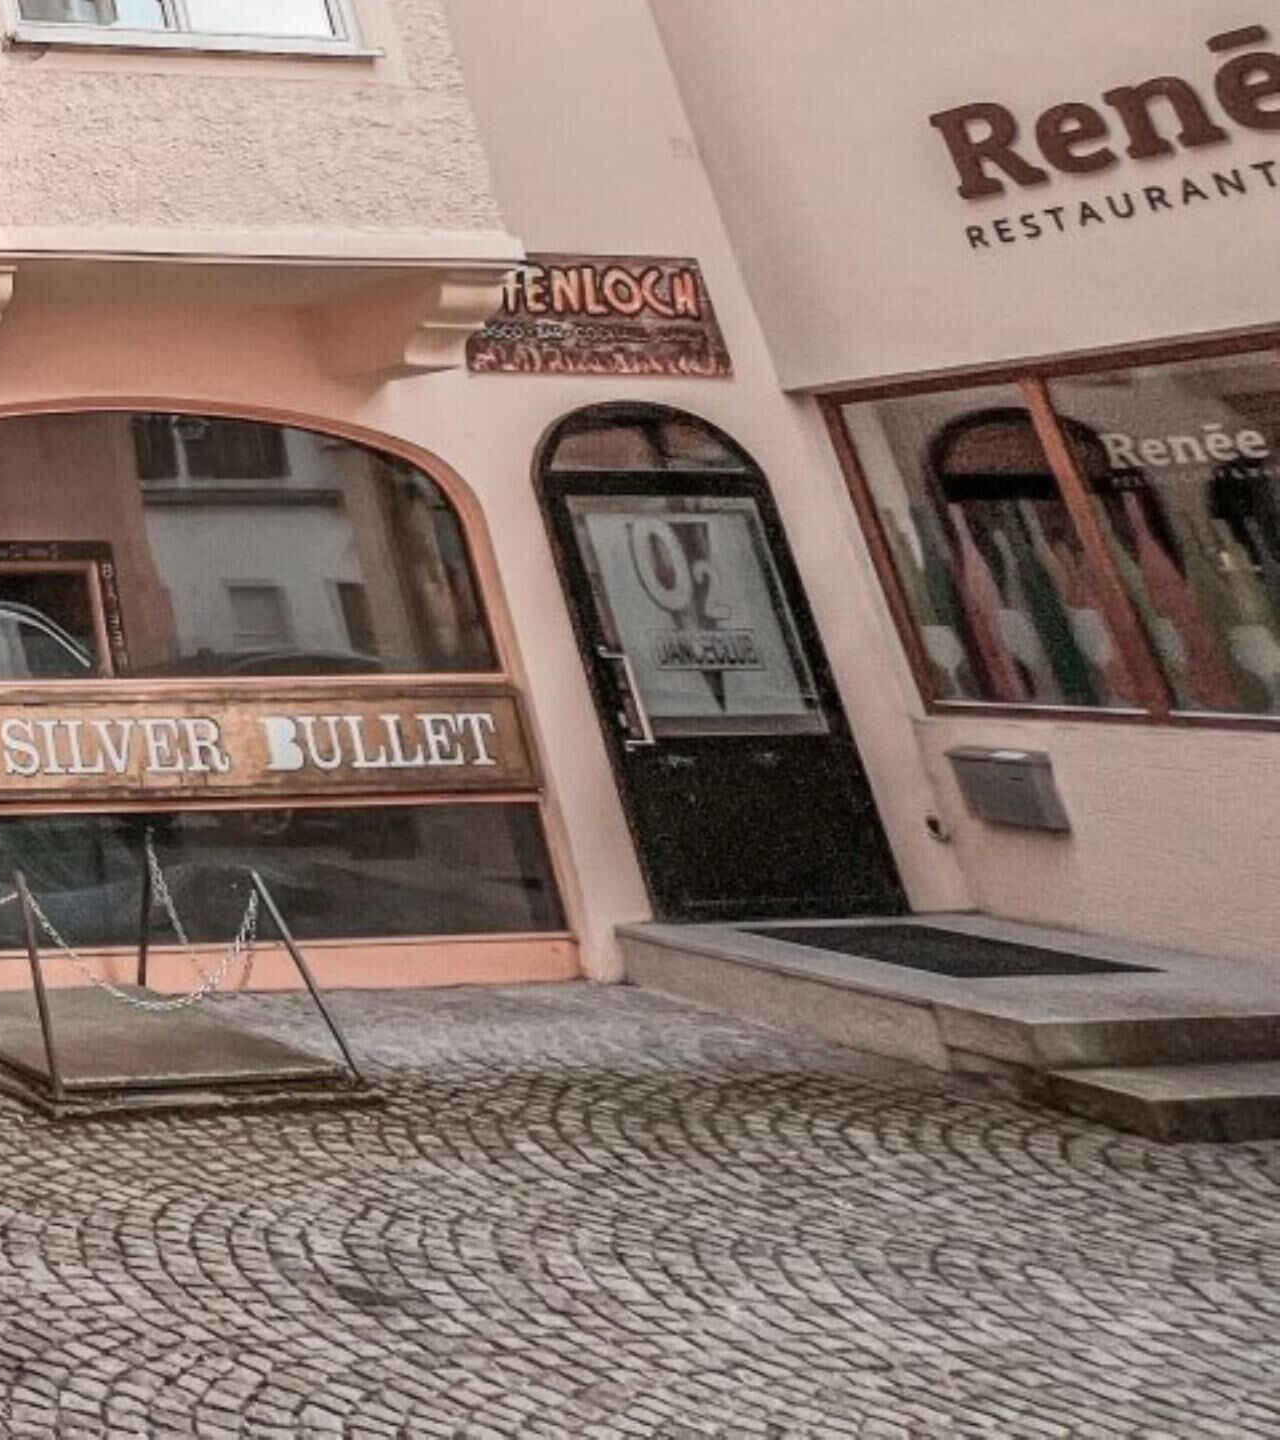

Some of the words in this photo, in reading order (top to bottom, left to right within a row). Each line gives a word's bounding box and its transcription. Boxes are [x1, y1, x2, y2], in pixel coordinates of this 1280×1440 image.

[966, 161, 1280, 248] RESTAURANT
[0, 717, 229, 776] SILVER
[258, 713, 496, 771] BULLET
